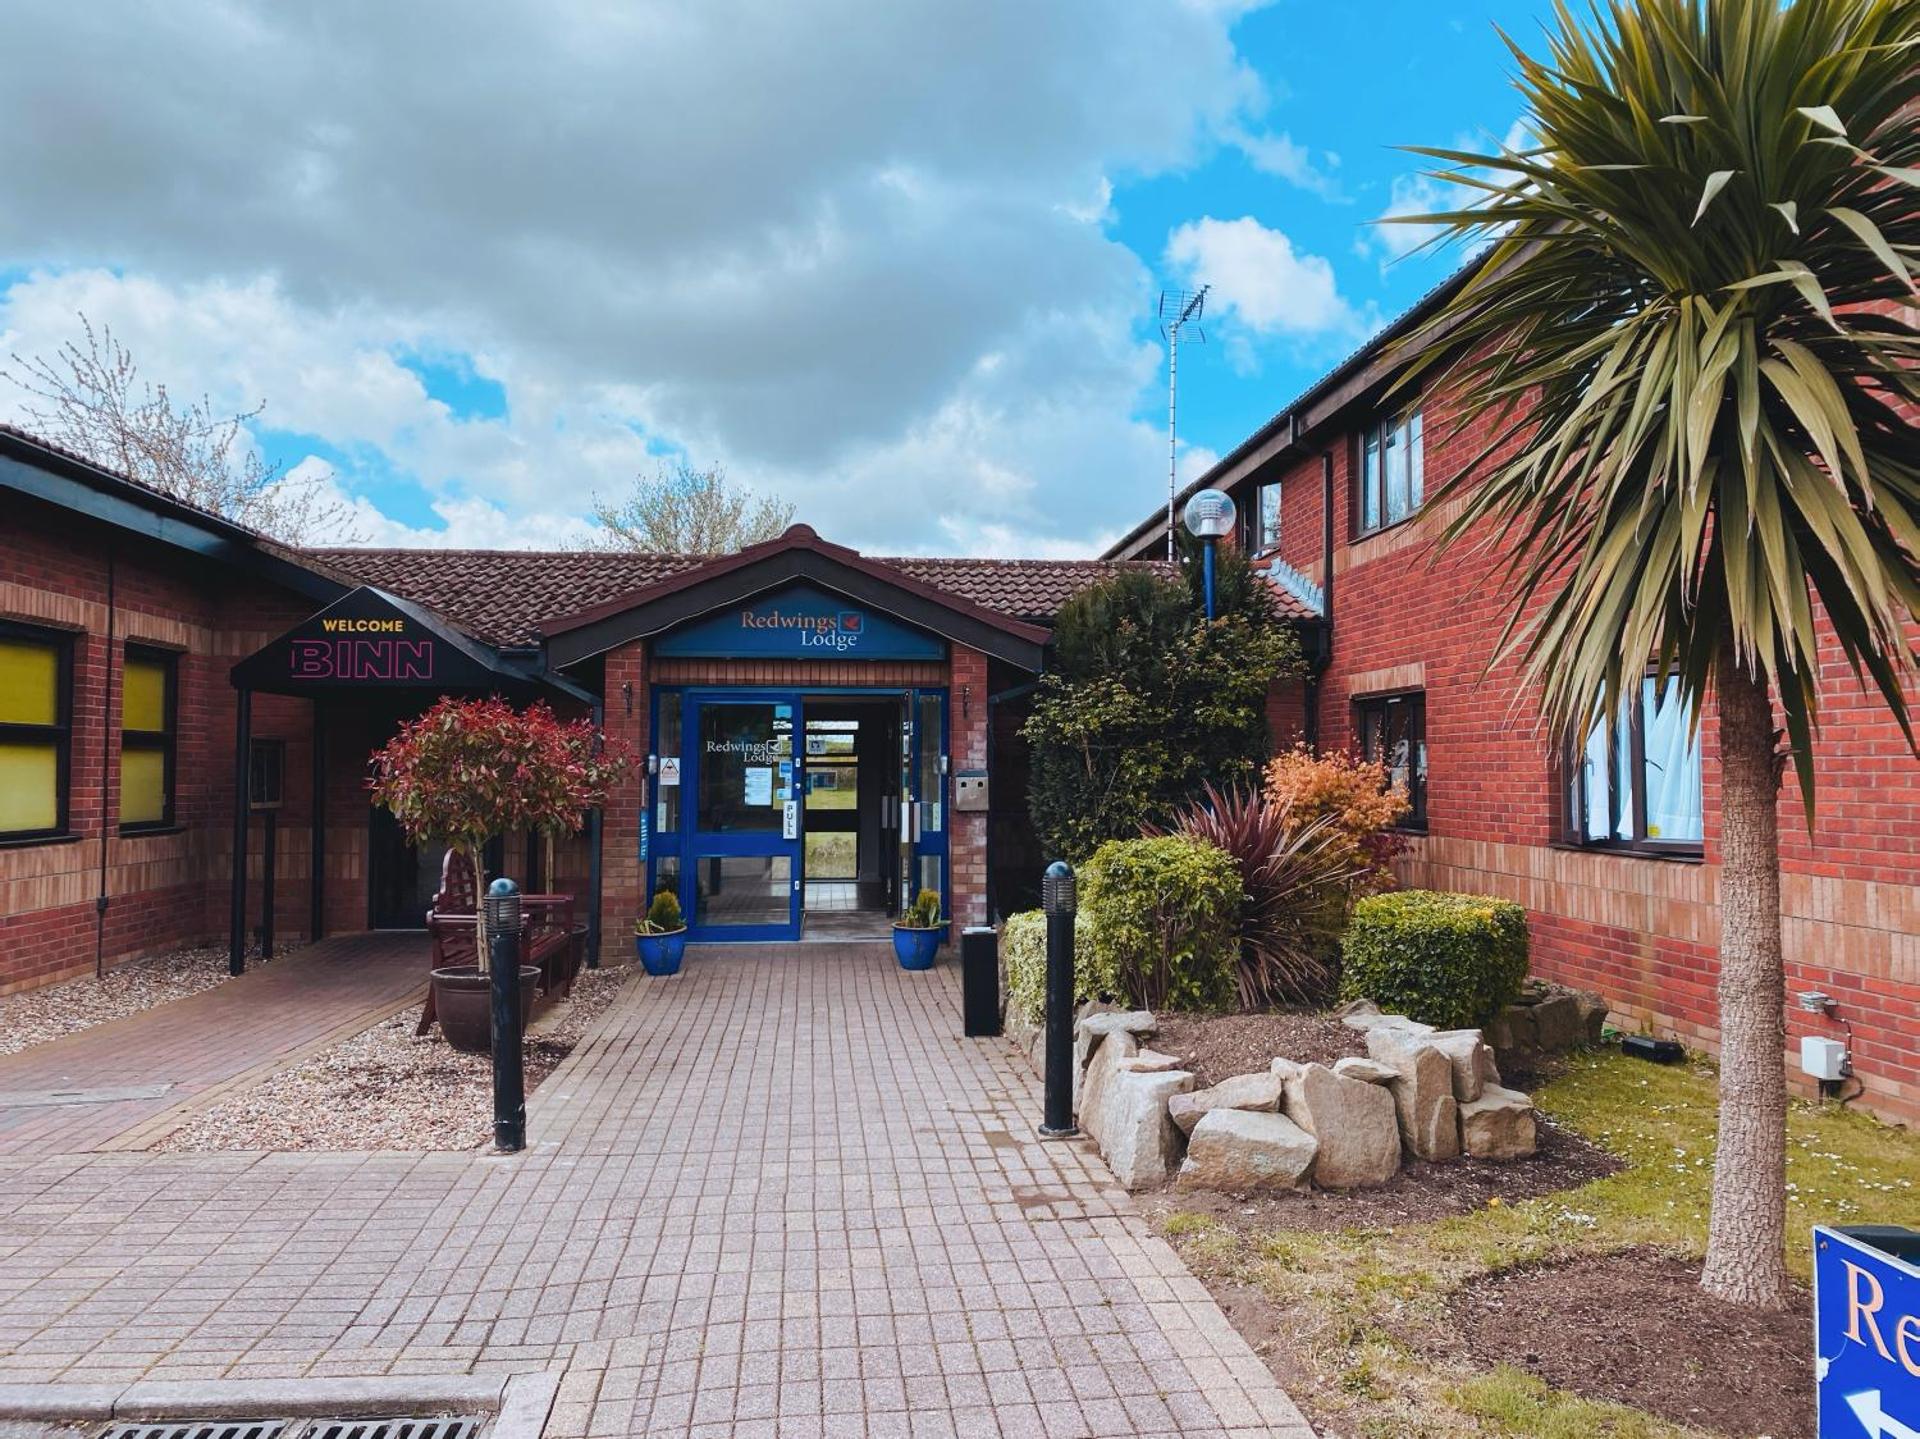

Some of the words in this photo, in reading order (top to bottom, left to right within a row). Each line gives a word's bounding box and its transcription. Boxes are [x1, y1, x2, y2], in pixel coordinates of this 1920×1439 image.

[323, 619, 404, 632] WELCOME
[741, 611, 837, 634] Redwings
[801, 630, 857, 651] Lodge
[290, 640, 433, 679] BINN
[706, 741, 766, 756] Redwings
